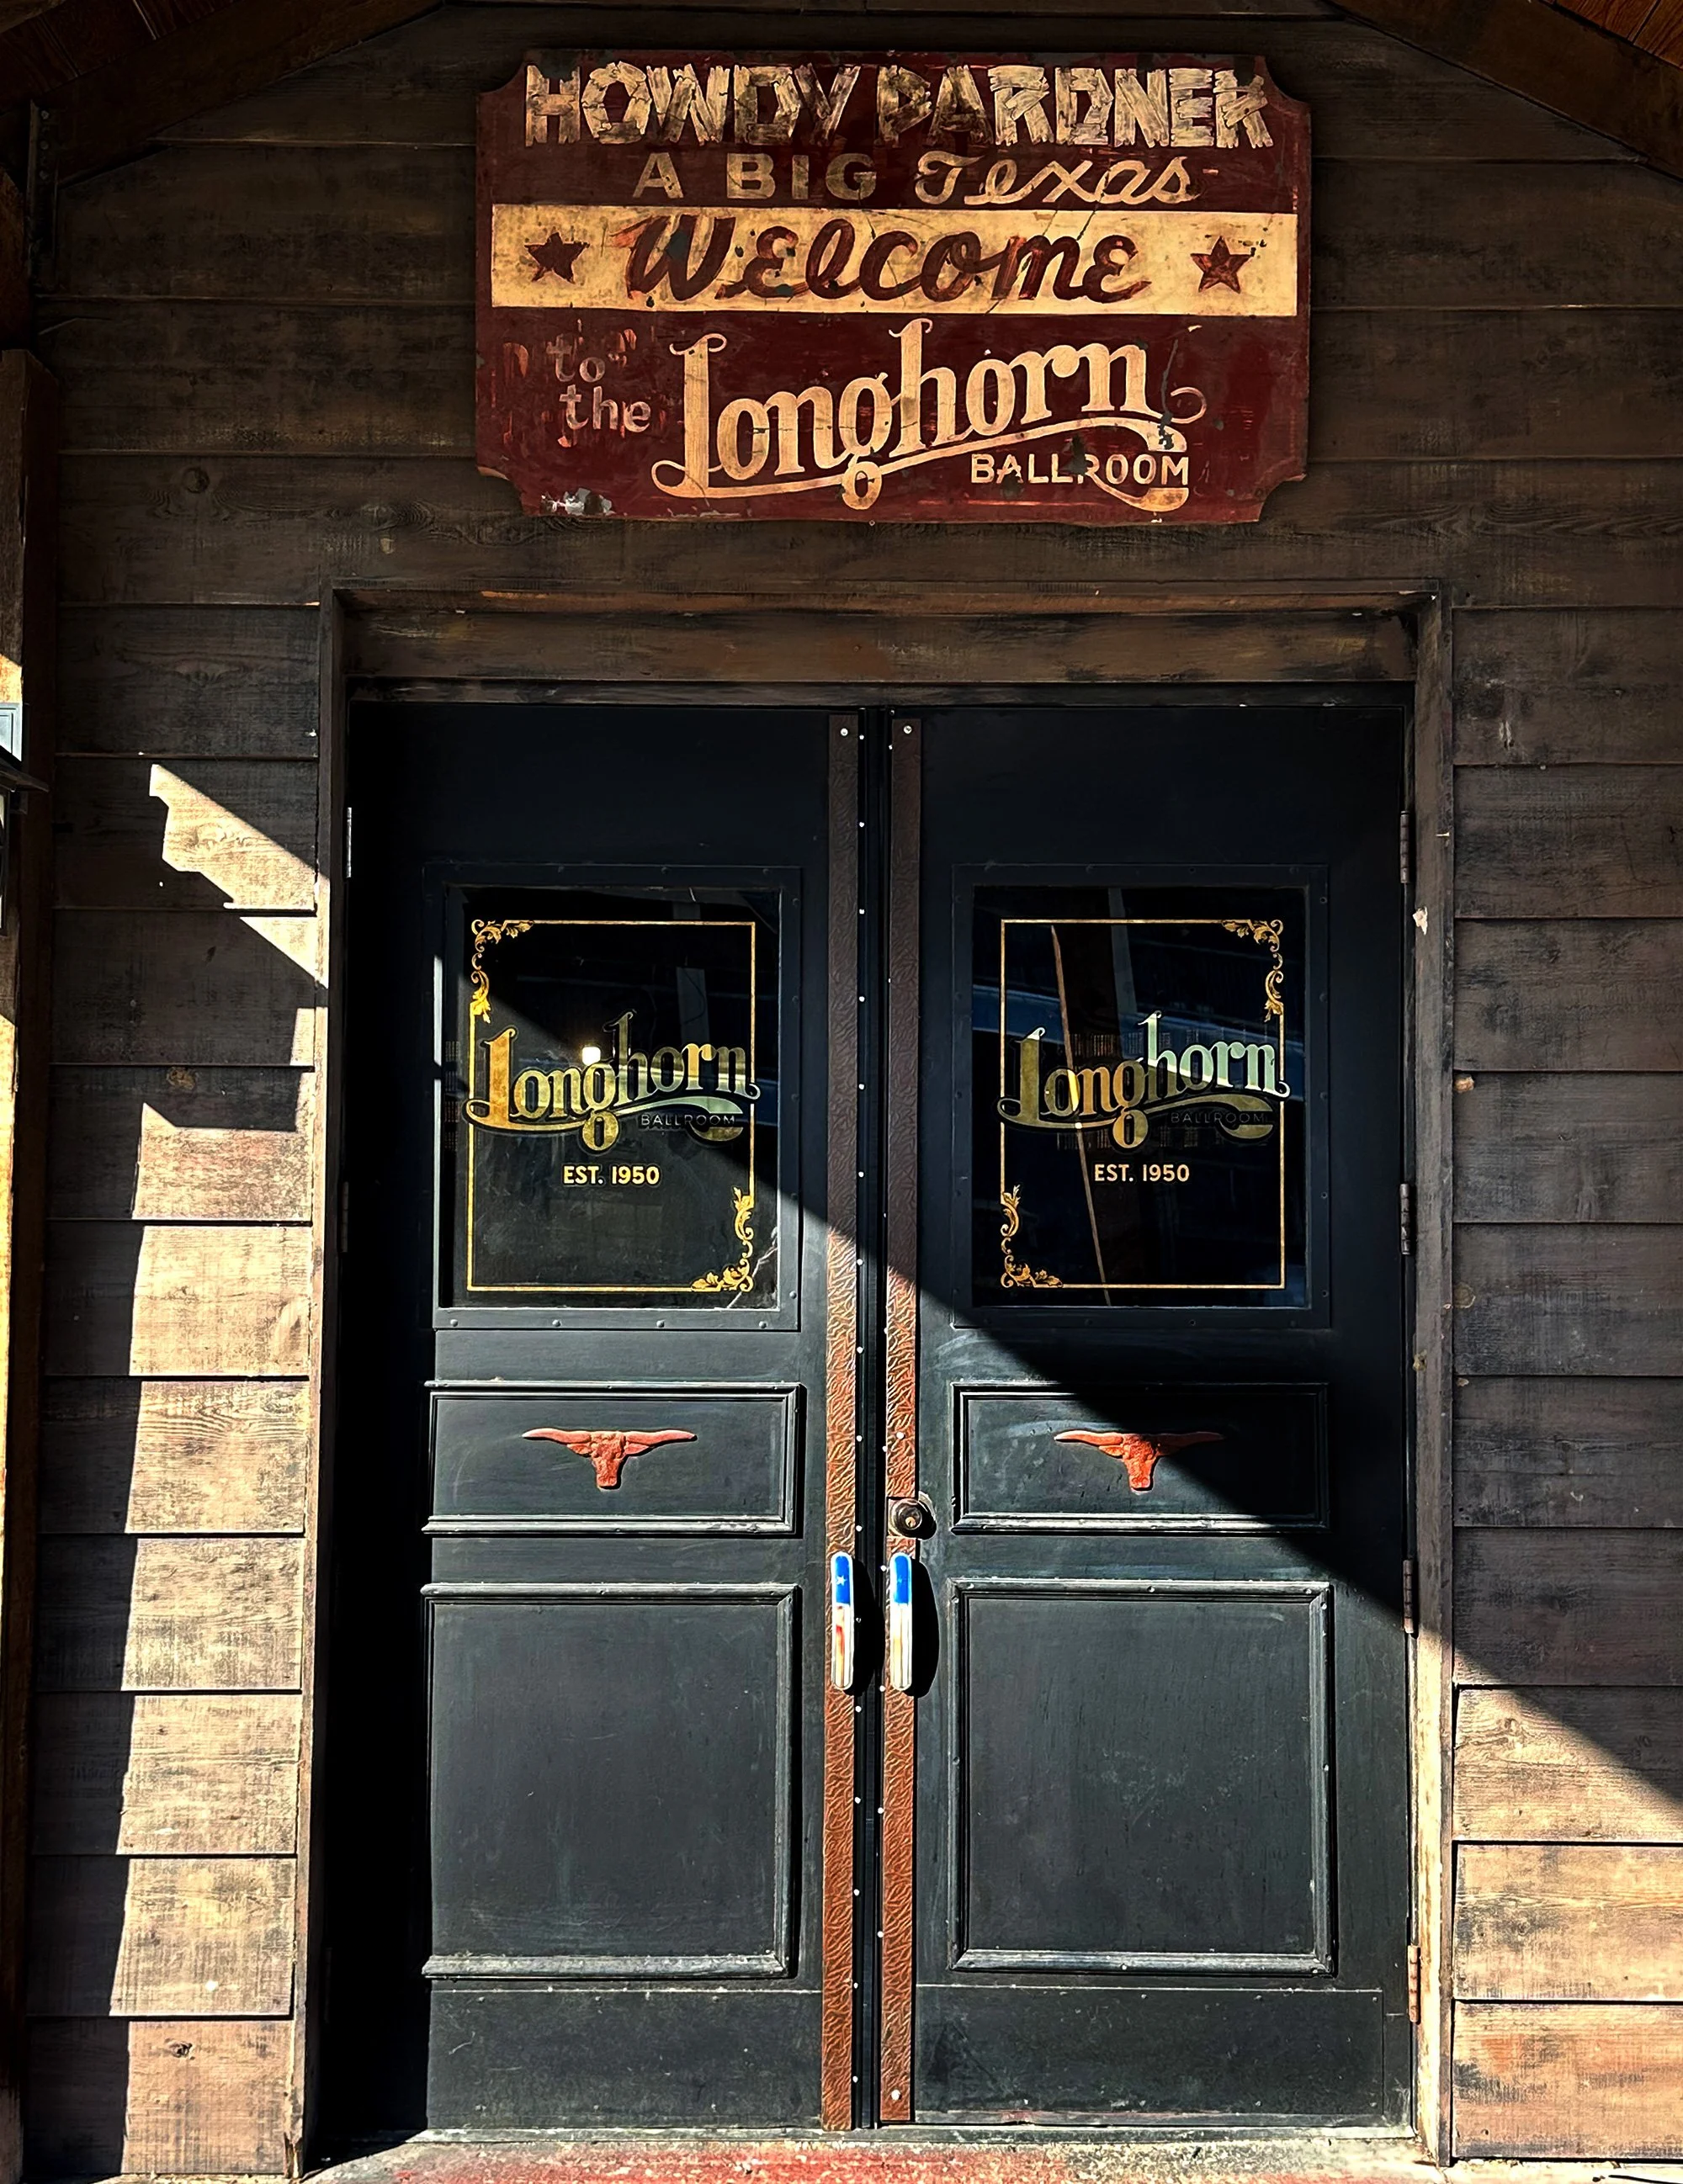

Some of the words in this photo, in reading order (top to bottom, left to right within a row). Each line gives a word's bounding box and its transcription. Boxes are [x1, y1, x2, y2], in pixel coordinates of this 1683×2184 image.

[525, 61, 861, 146] HOWDY
[877, 65, 1274, 149] PARDNER
[633, 152, 684, 199] A
[727, 152, 877, 200] BIG
[916, 151, 1203, 204] Texas
[619, 215, 1152, 304] Welcome
[546, 333, 606, 383] to
[560, 384, 650, 432] the
[651, 318, 1207, 510] Longhorn
[970, 453, 1189, 488] BALLROOM
[466, 1010, 761, 1151] Longhorn
[997, 1010, 1291, 1149] Longhorn
[640, 1113, 736, 1128] BALLROOM
[1171, 1111, 1266, 1125] BALLROOM
[563, 1165, 604, 1185] EST.
[612, 1165, 660, 1185] 1950
[1094, 1164, 1134, 1183] EST.
[1143, 1164, 1191, 1183] 1950
